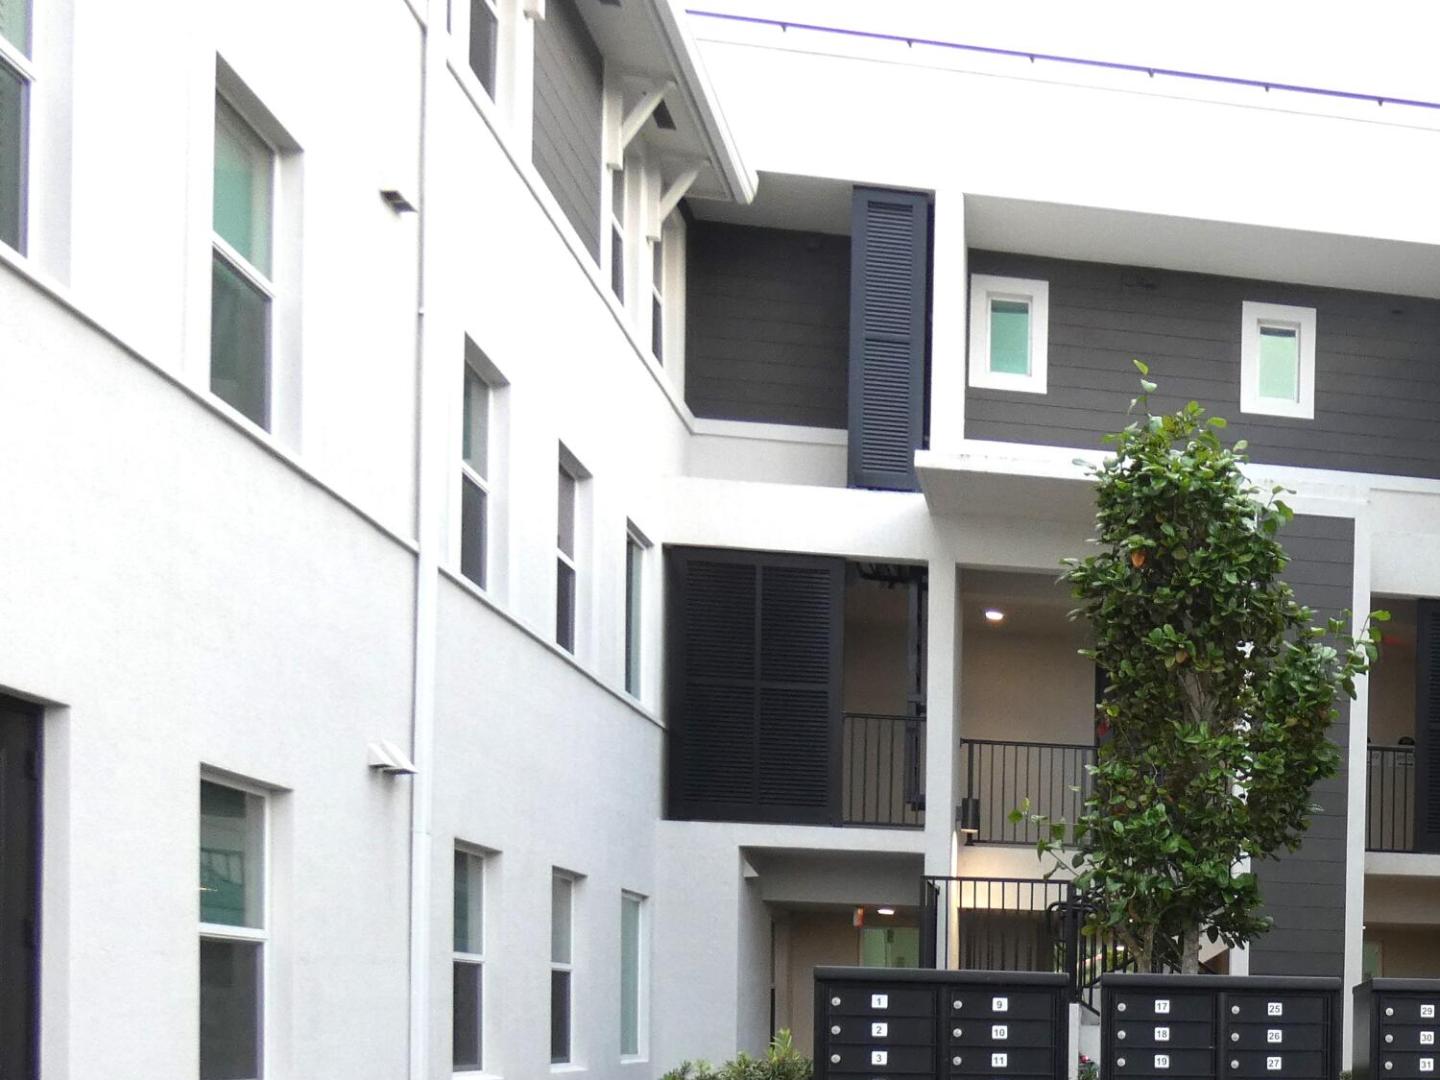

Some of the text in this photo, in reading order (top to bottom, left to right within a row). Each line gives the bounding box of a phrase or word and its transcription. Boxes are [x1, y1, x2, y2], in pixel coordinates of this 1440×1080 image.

[1156, 1002, 1168, 1011] 17
[1268, 1004, 1281, 1014] 25
[1422, 1007, 1433, 1016] 29
[994, 1028, 1006, 1037] 10
[1156, 1030, 1168, 1038] 18
[1268, 1032, 1280, 1041] 26
[1421, 1033, 1433, 1042] 30
[994, 1056, 1004, 1065] 11
[1156, 1056, 1168, 1066] 19
[1268, 1059, 1280, 1068] 27
[1422, 1060, 1432, 1069] 31
